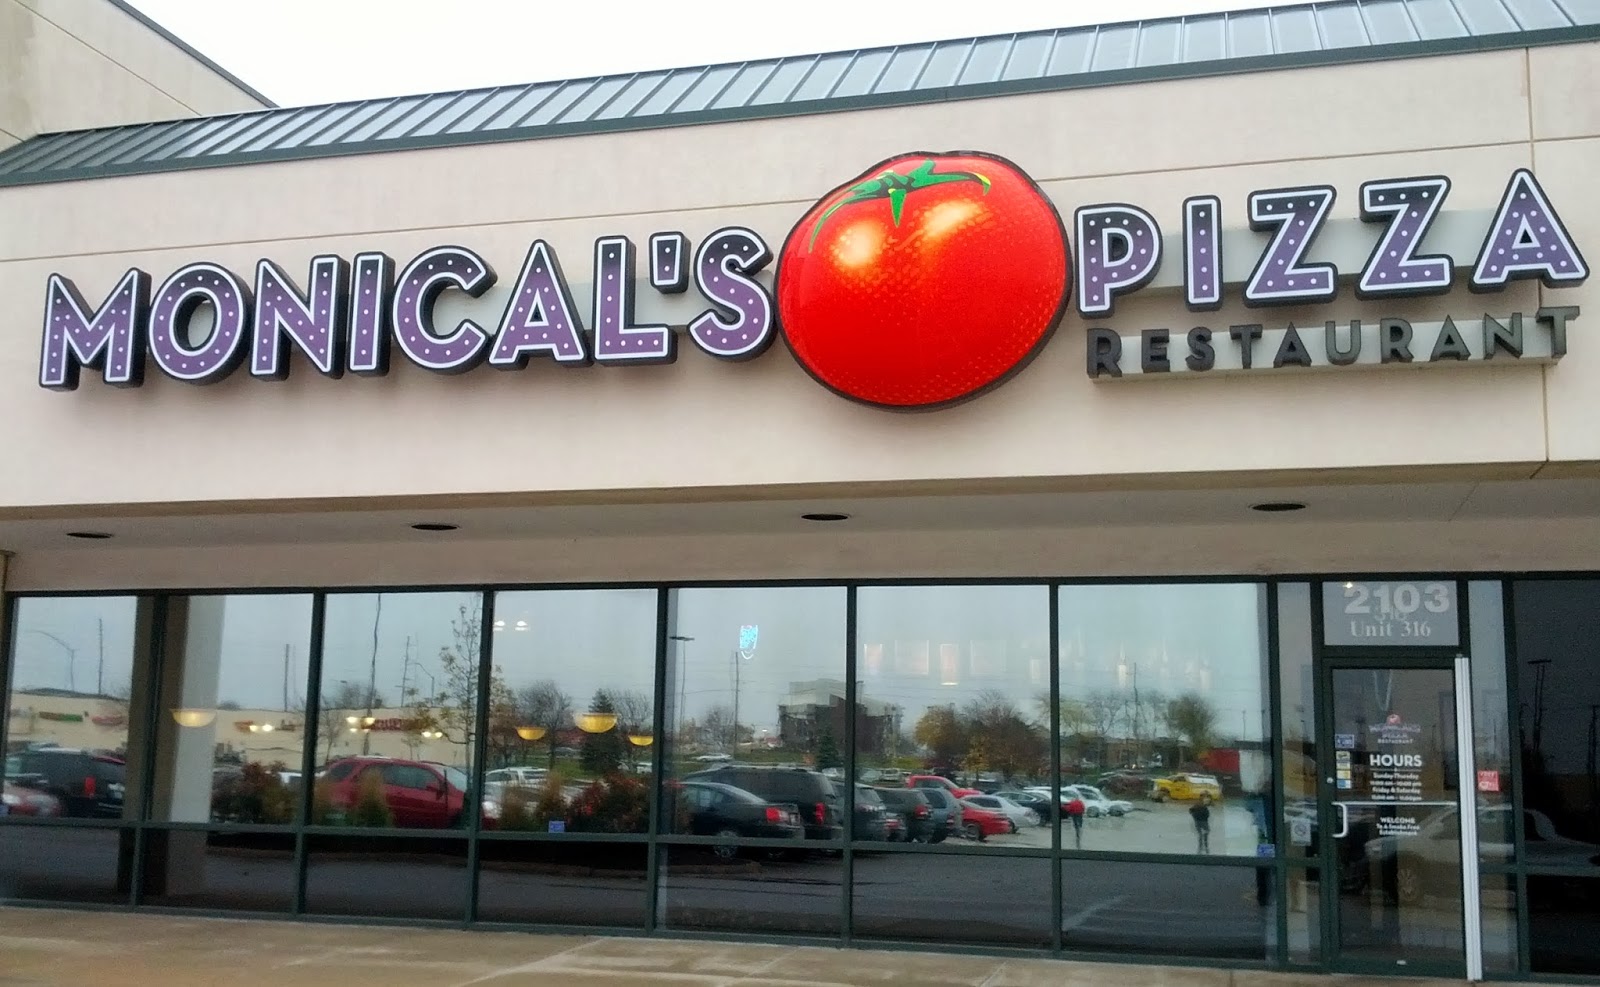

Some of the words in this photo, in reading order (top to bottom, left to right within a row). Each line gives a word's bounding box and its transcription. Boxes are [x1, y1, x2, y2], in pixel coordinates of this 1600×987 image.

[1074, 168, 1590, 318] PIZZA
[39, 227, 776, 389] MONICAL'S
[1087, 306, 1580, 378] RESTAURANT
[1344, 583, 1450, 614] 2103
[1350, 620, 1393, 638] Unit
[1401, 620, 1431, 637] 316
[1369, 754, 1423, 767] HOURS
